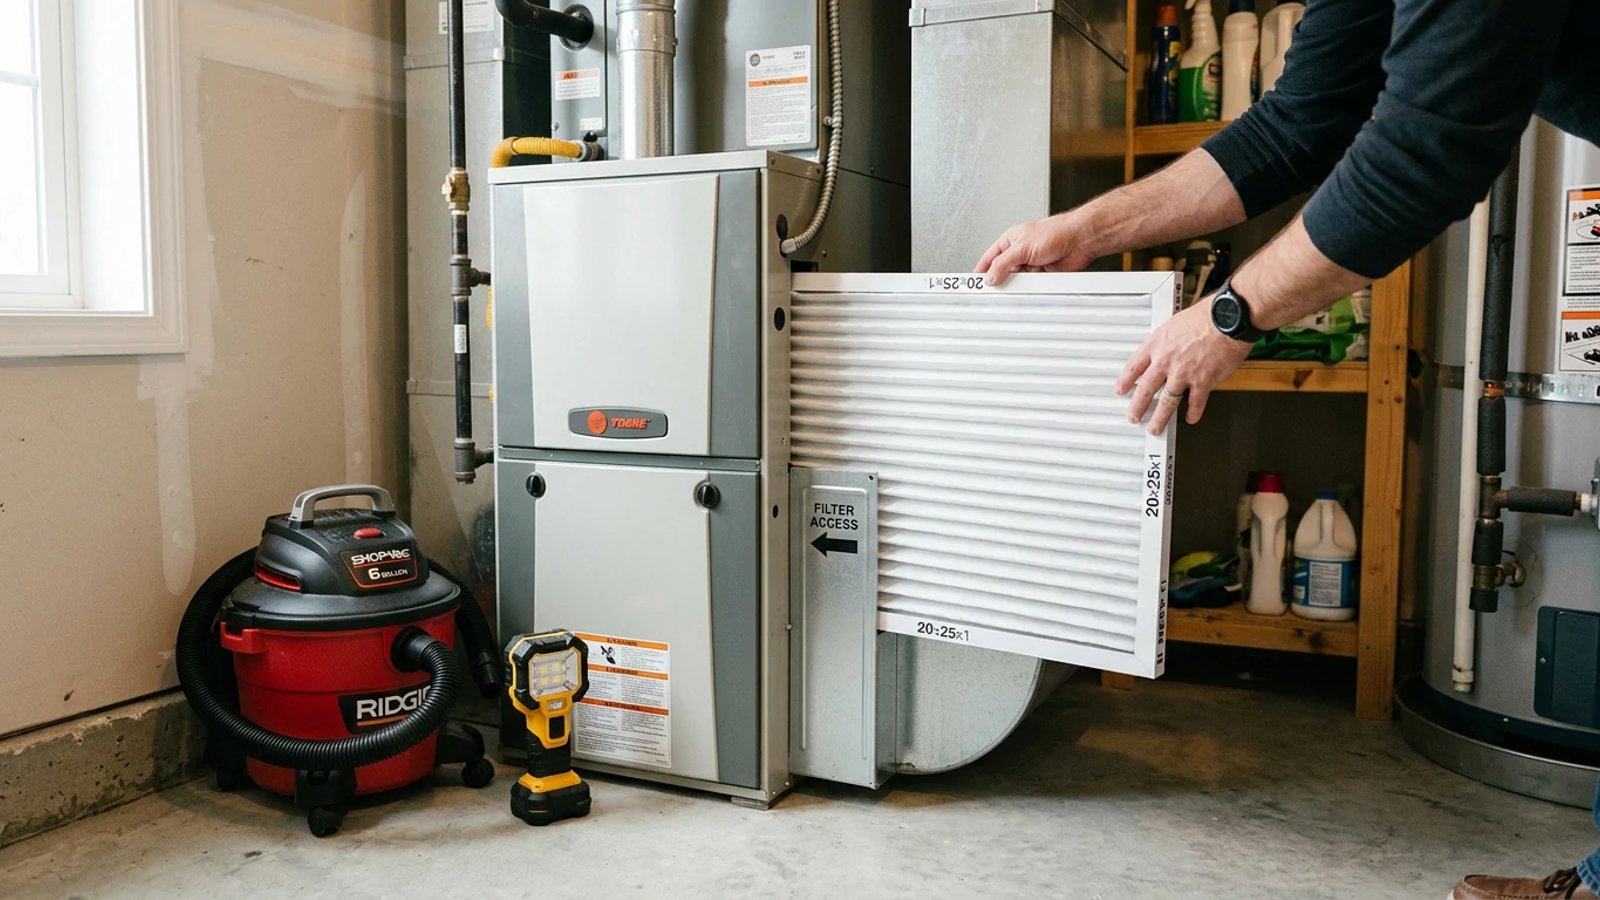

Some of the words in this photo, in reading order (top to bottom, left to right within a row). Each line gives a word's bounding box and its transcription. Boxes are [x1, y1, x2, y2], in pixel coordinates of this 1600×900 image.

[1145, 454, 1161, 518] 20x25x1
[814, 503, 855, 516] FILTER
[810, 517, 859, 531] ACCESS
[368, 567, 381, 580] 6
